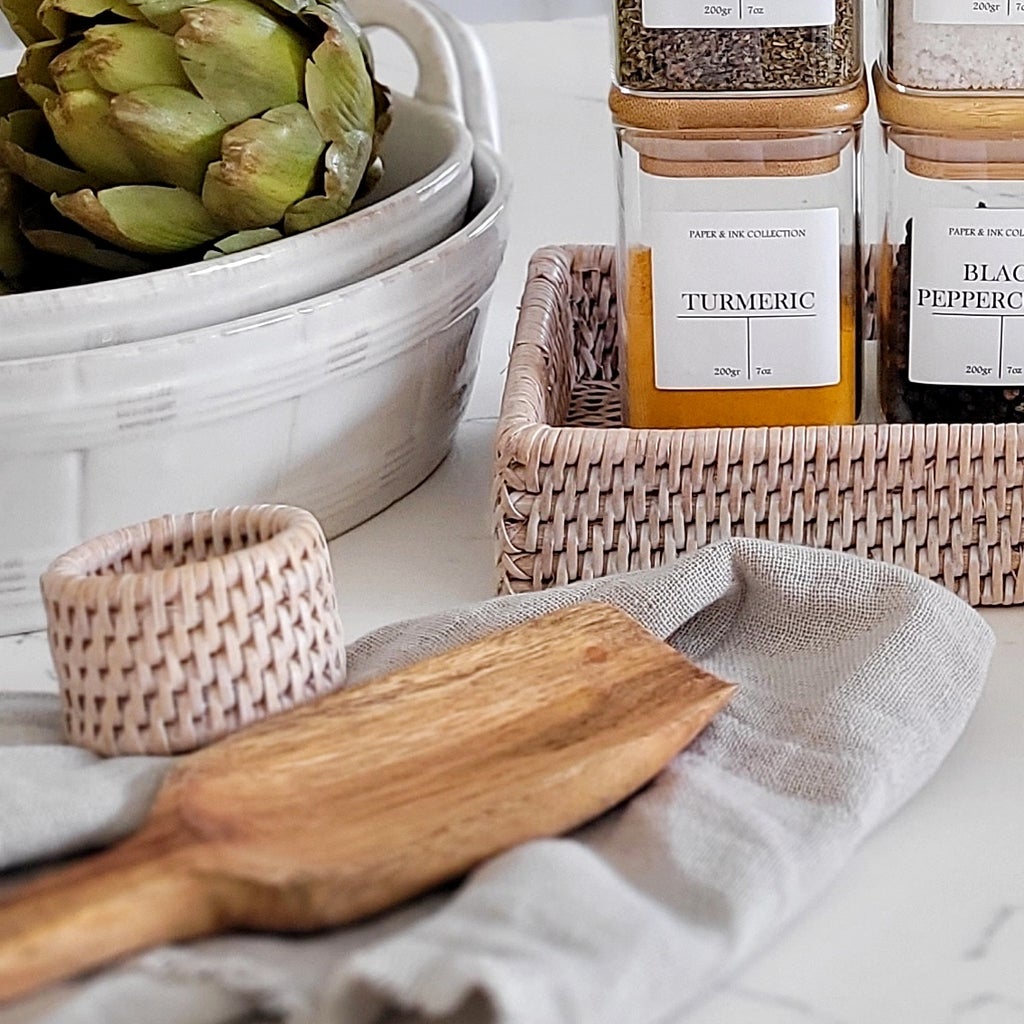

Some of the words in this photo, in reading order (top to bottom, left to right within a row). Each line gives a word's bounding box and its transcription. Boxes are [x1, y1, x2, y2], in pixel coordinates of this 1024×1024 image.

[703, 5, 733, 17] 200gr
[747, 5, 765, 16] 7oz
[972, 1, 1001, 13] 200gr
[689, 230, 718, 239] PAPER
[718, 230, 726, 239] &
[727, 230, 745, 239] INK
[746, 229, 807, 239] COLLECTION
[948, 227, 977, 237] PAPER
[977, 228, 985, 237] &
[986, 228, 1005, 237] INK
[682, 292, 815, 311] TURMERIC
[713, 367, 742, 378] 200gr
[755, 367, 773, 376] 7oz
[965, 365, 993, 376] 200gr
[1006, 366, 1023, 375] 7oz
